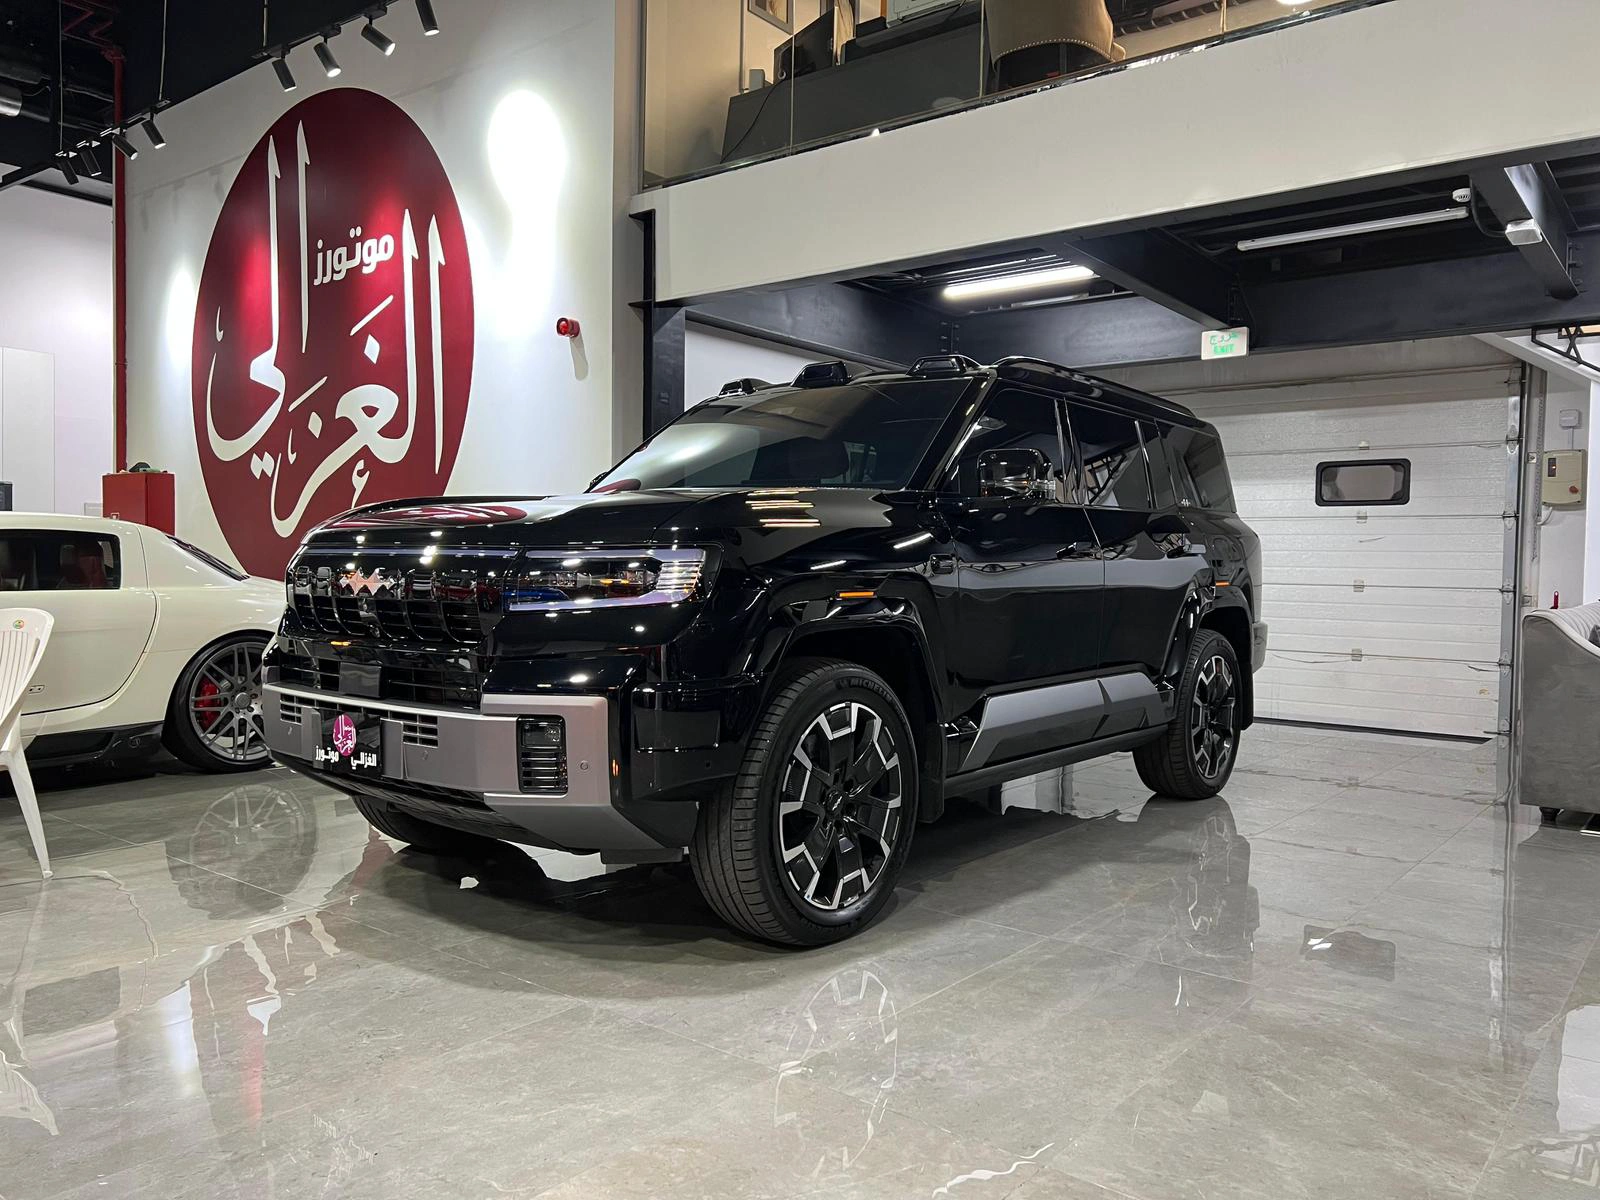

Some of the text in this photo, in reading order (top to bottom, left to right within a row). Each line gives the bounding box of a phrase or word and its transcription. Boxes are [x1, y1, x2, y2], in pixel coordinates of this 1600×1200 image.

[313, 226, 395, 286] موتورز
[849, 677, 893, 703] MICHELIN
[315, 745, 377, 770] الغزالي موتورز
